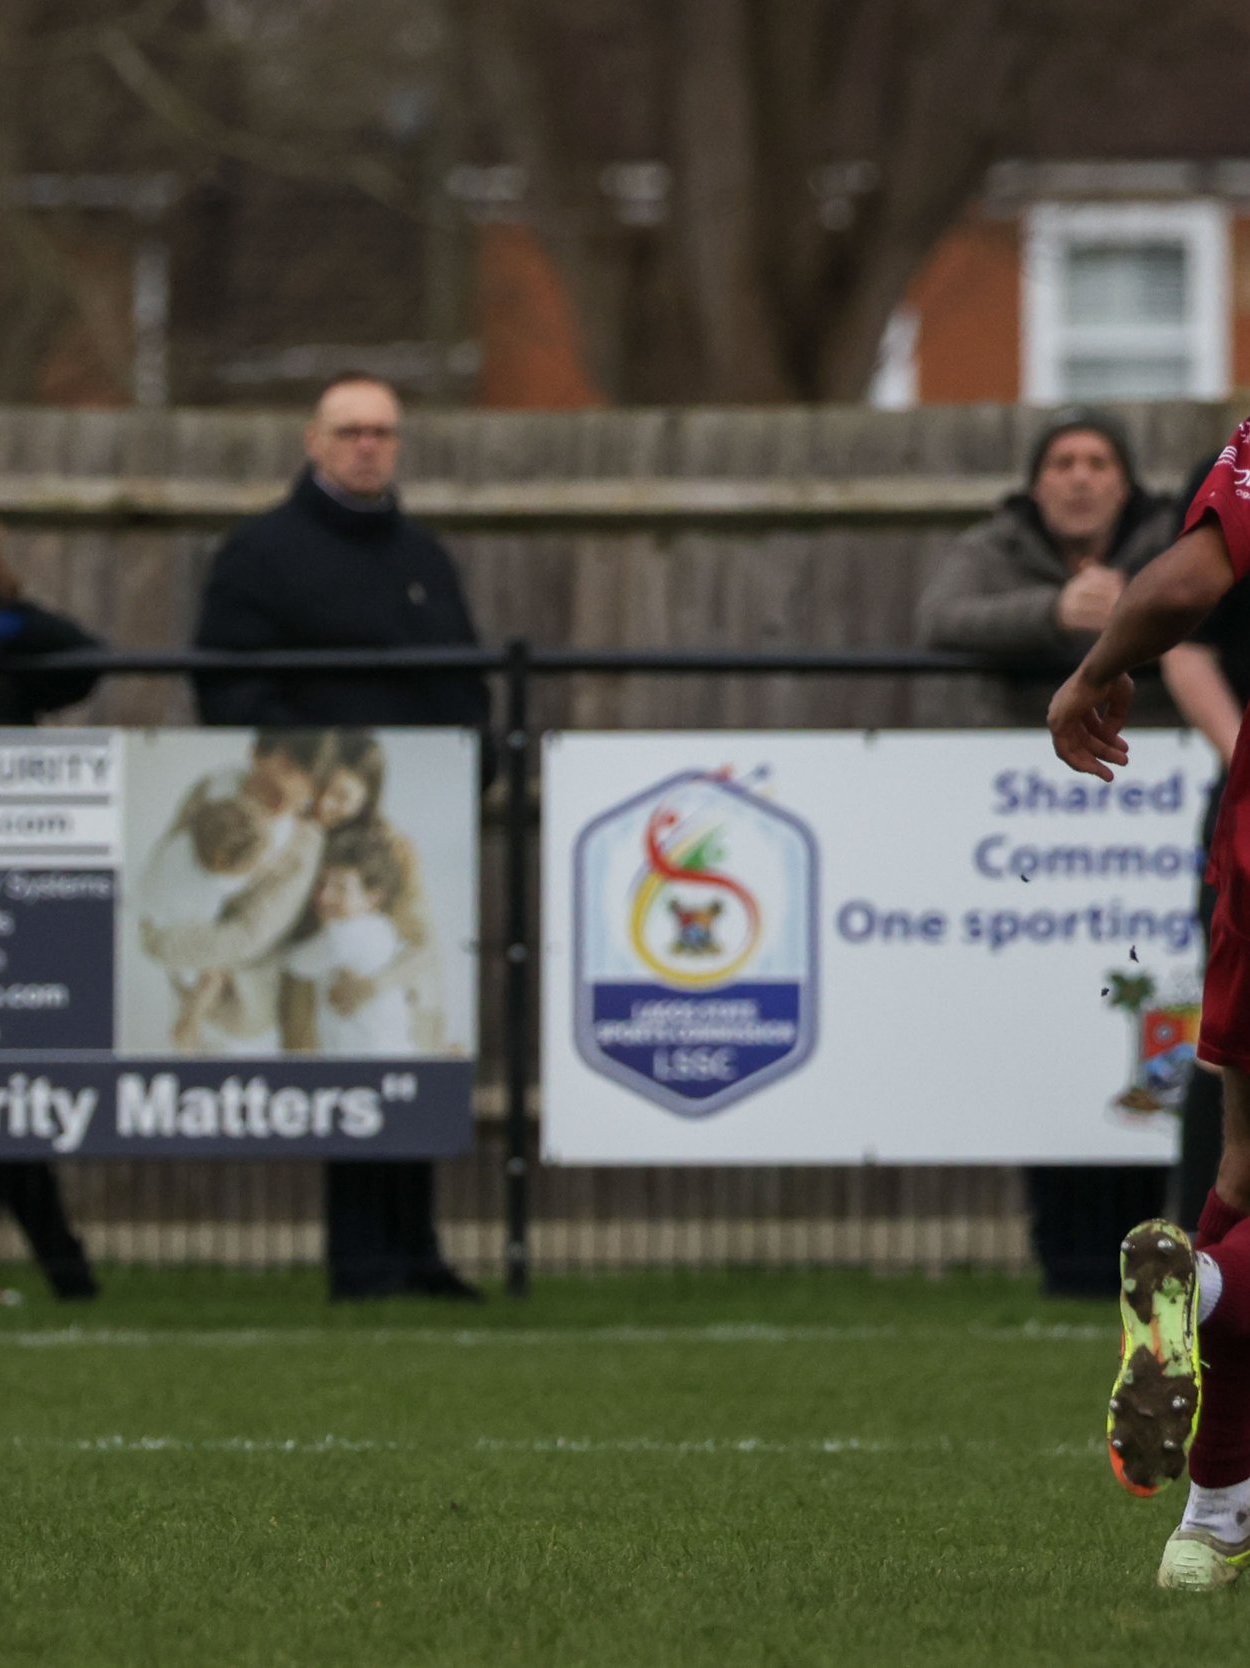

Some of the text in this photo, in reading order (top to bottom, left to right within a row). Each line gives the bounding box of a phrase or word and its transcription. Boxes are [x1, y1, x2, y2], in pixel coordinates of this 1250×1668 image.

[993, 769, 1185, 815] Shared
[5, 872, 113, 905] Systems
[837, 899, 1200, 955] One sporting
[652, 1046, 736, 1081] LSSC
